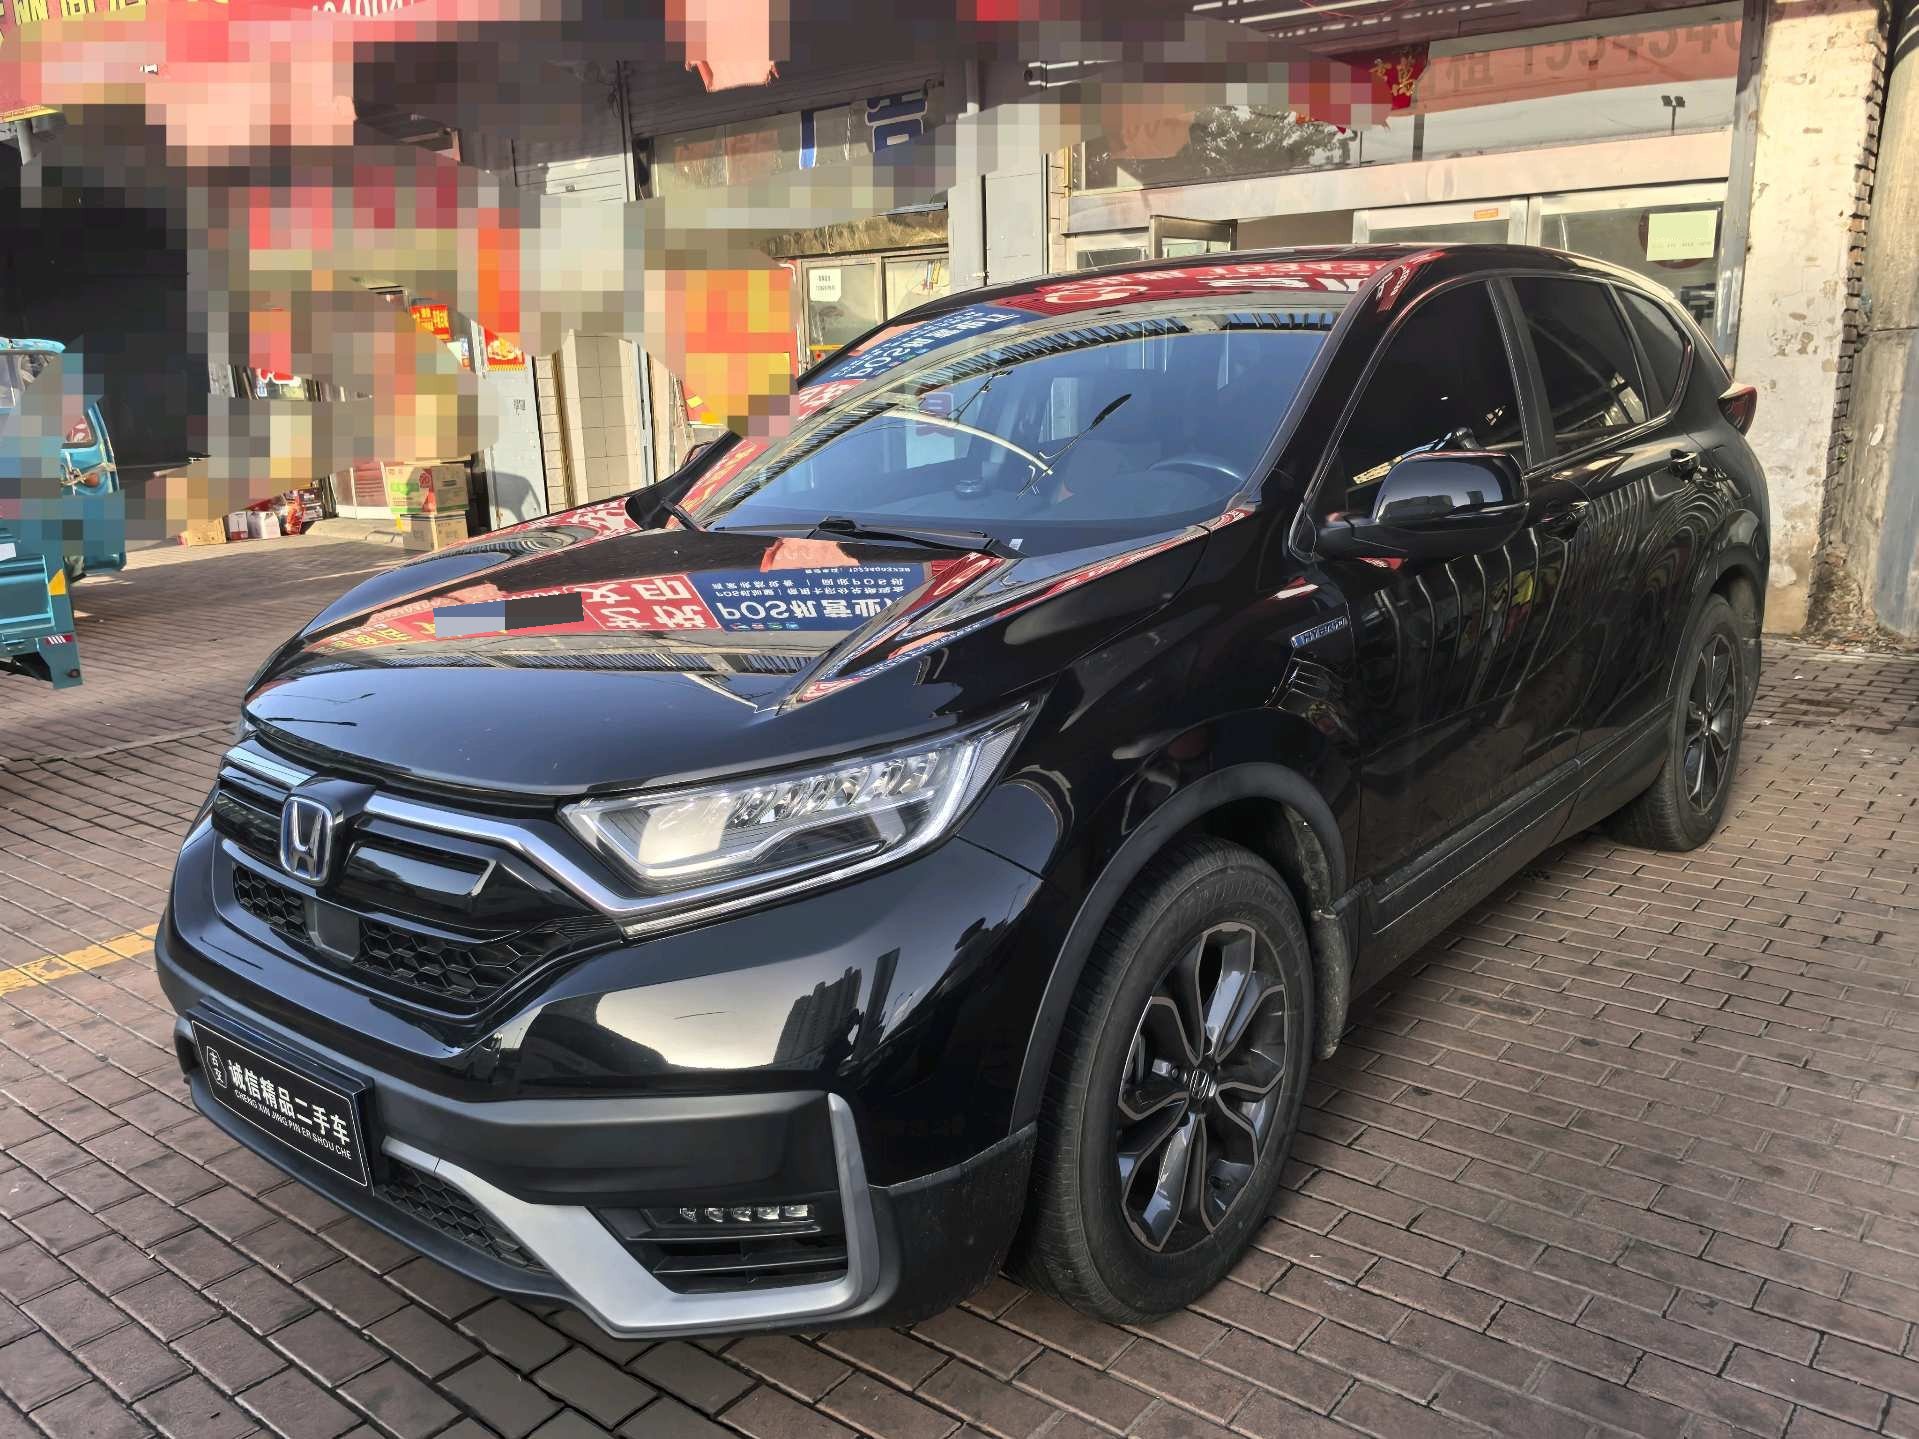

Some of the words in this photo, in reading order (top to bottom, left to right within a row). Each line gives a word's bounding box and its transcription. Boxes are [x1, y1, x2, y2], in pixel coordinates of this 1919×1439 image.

[228, 1059, 350, 1145] 诚信精品二手车
[234, 1089, 258, 1110] CHENG
[258, 1104, 271, 1117] XIN
[271, 1111, 288, 1127] JING
[288, 1119, 301, 1134] PIN
[301, 1125, 312, 1140] ER
[312, 1132, 335, 1152] SHOU
[335, 1145, 353, 1160] CHE
